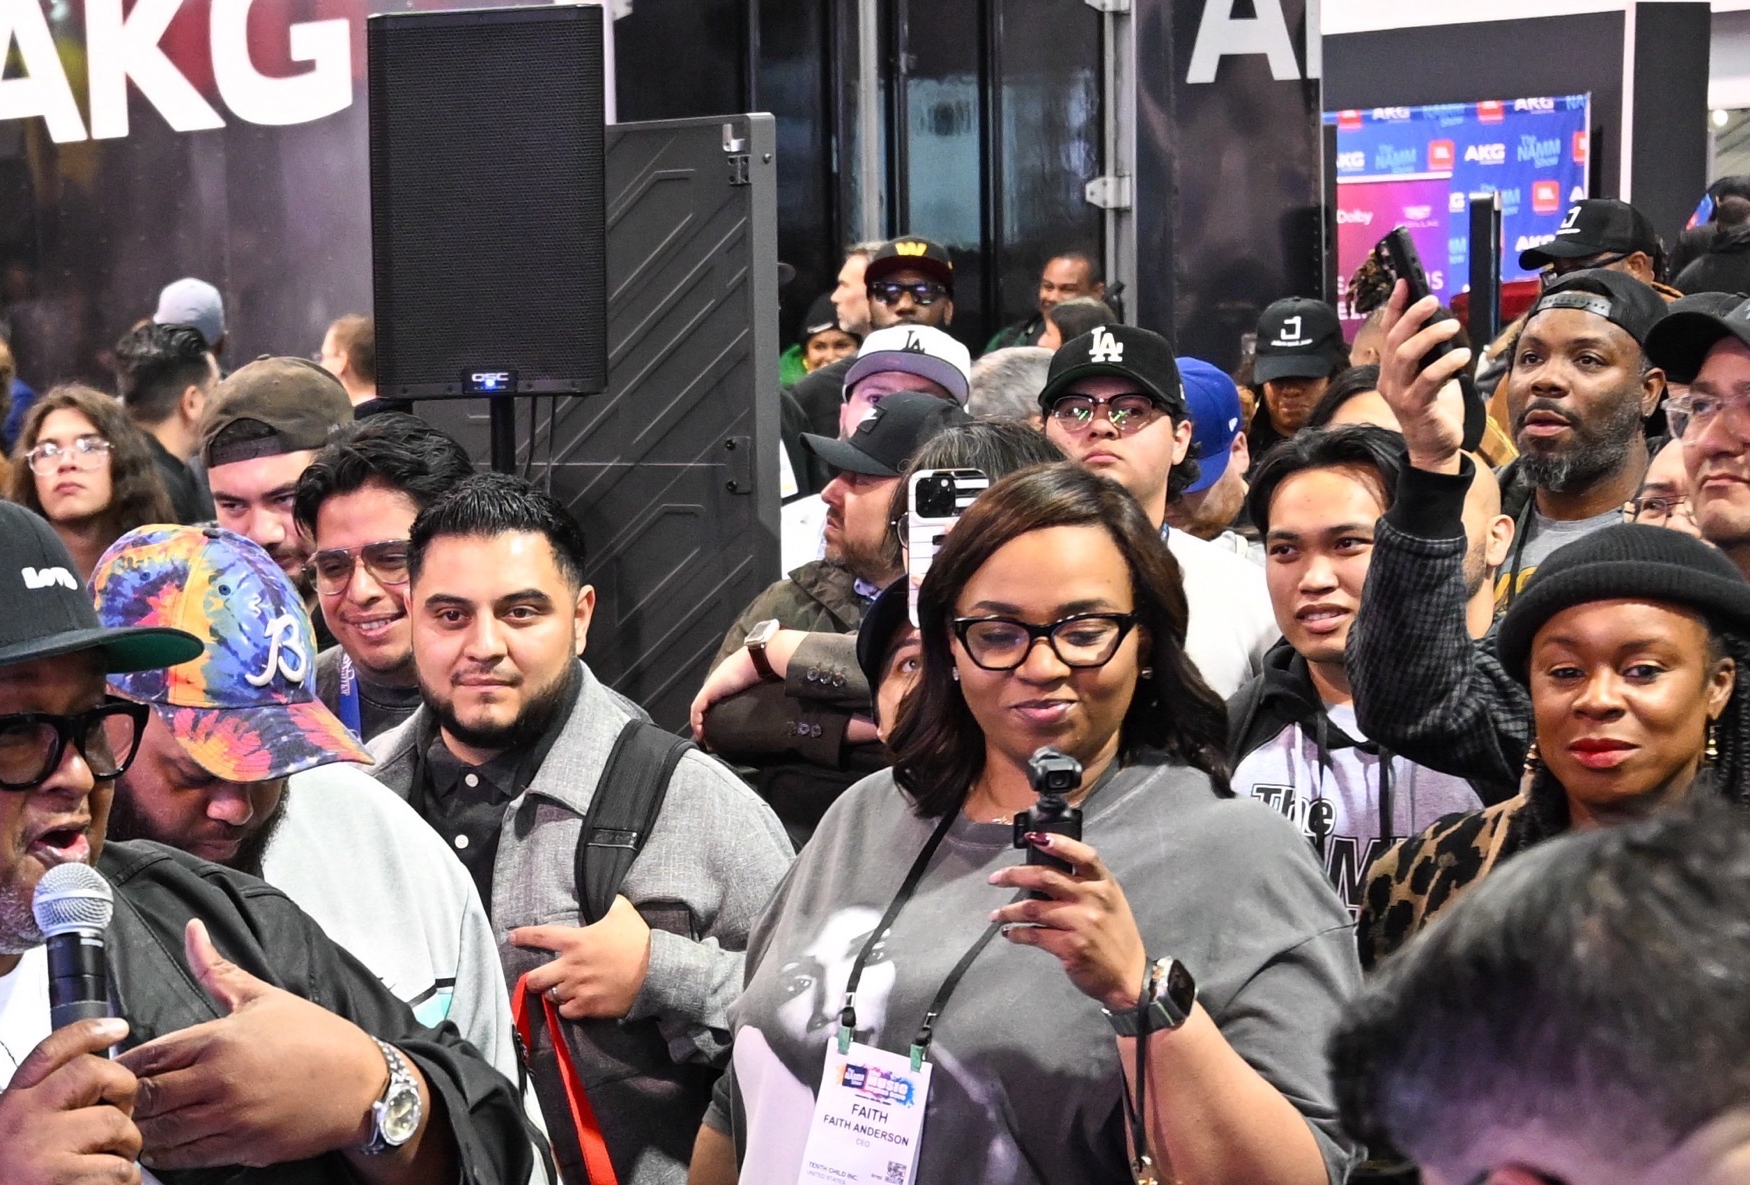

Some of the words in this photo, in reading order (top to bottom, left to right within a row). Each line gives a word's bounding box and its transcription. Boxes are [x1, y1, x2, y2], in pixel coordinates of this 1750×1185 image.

[1464, 143, 1506, 162] AKG
[1336, 208, 1373, 226] Dolby
[900, 330, 926, 355] LA
[1088, 325, 1124, 363] LA
[472, 372, 509, 382] QSC
[245, 613, 307, 687] B
[1251, 783, 1338, 838] The
[851, 1103, 889, 1125] FAITH
[823, 1114, 852, 1131] FAITH
[852, 1123, 910, 1147] ANDERSON
[855, 1138, 871, 1149] CEO
[808, 1161, 828, 1173] TENTH
[828, 1166, 847, 1178] CHILD
